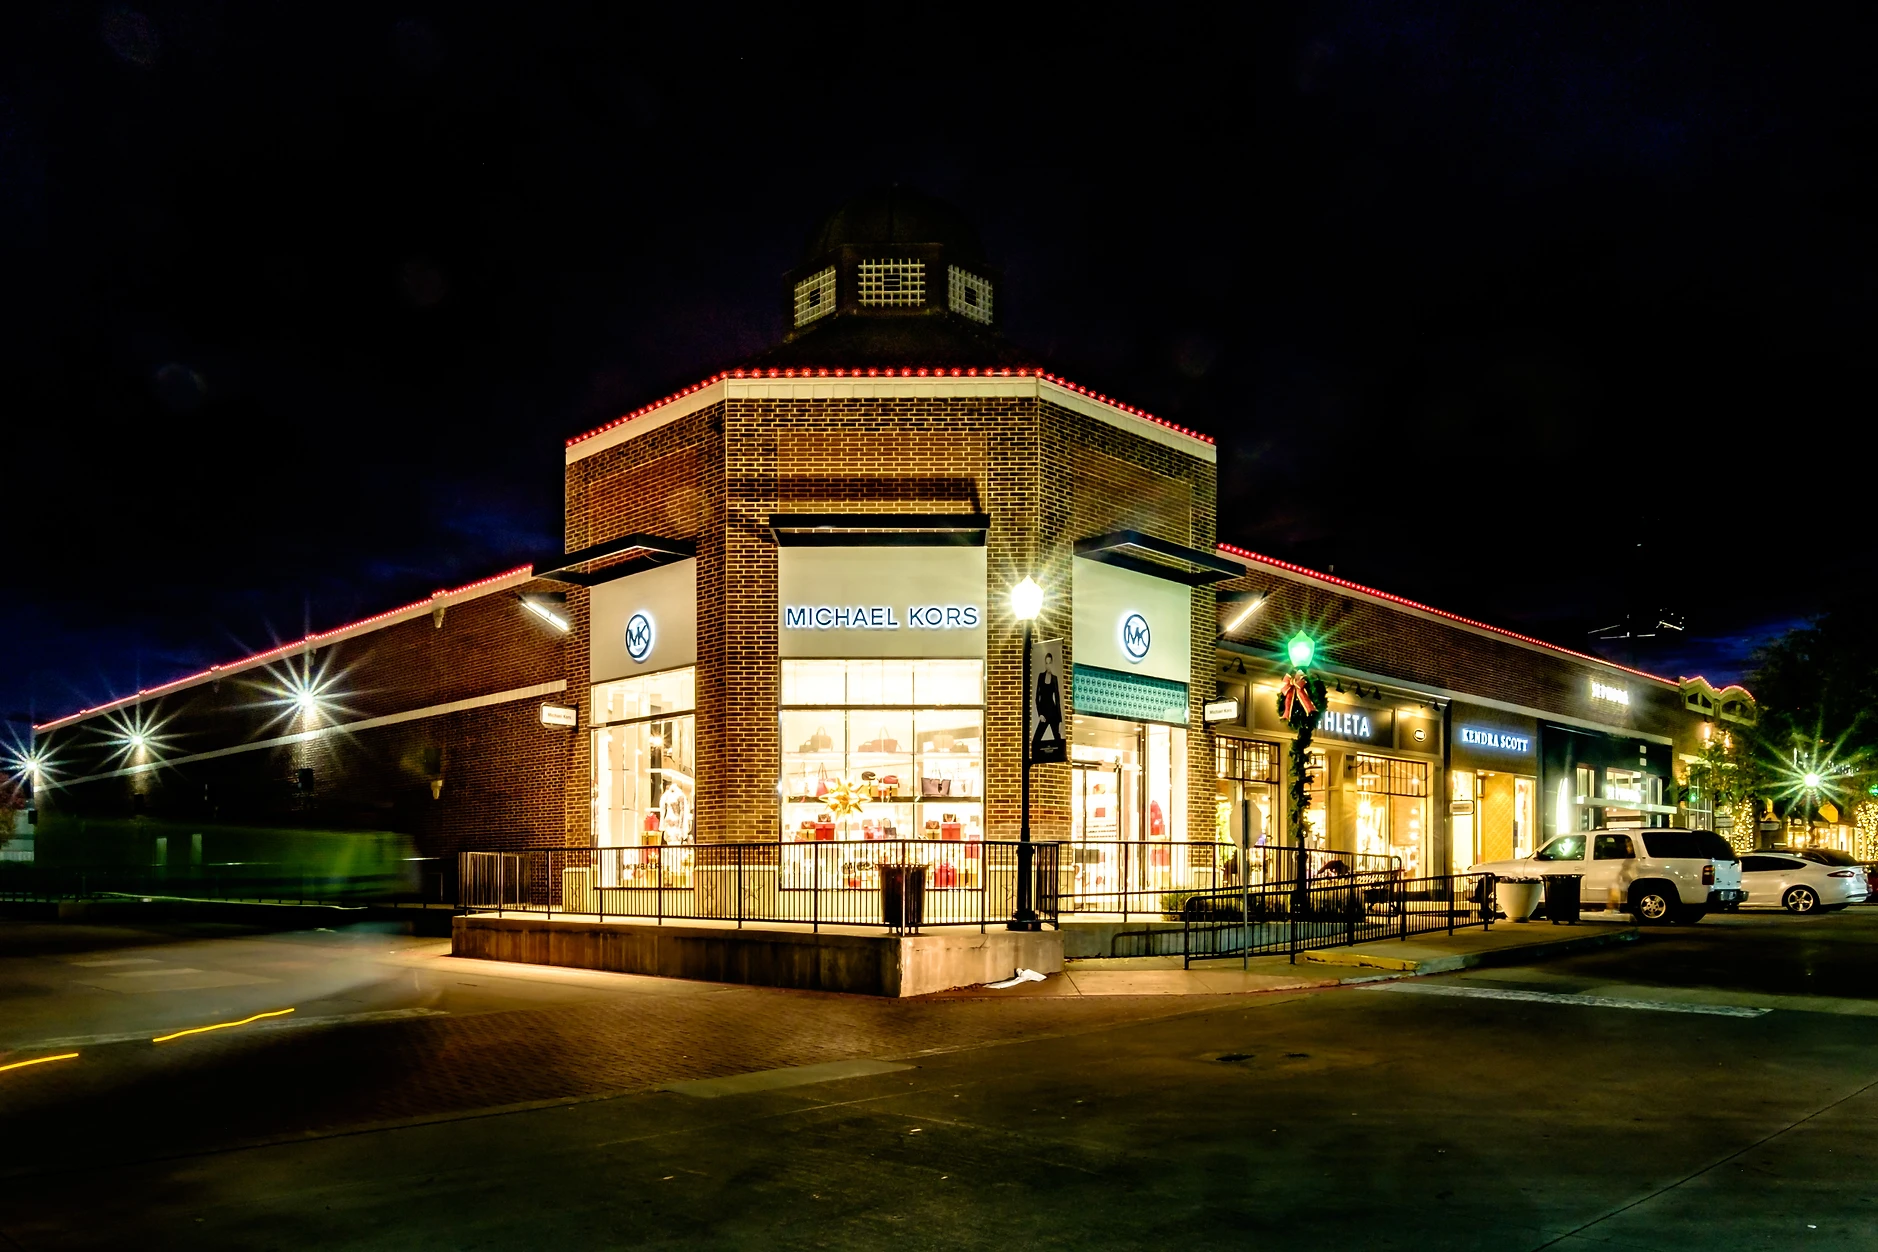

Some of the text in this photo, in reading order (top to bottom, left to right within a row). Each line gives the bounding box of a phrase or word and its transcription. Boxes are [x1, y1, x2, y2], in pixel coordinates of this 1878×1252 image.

[786, 606, 978, 627] MICHAEL KORS
[1317, 710, 1370, 738] HLETA
[1462, 727, 1529, 752] KENDRA SCOTT
